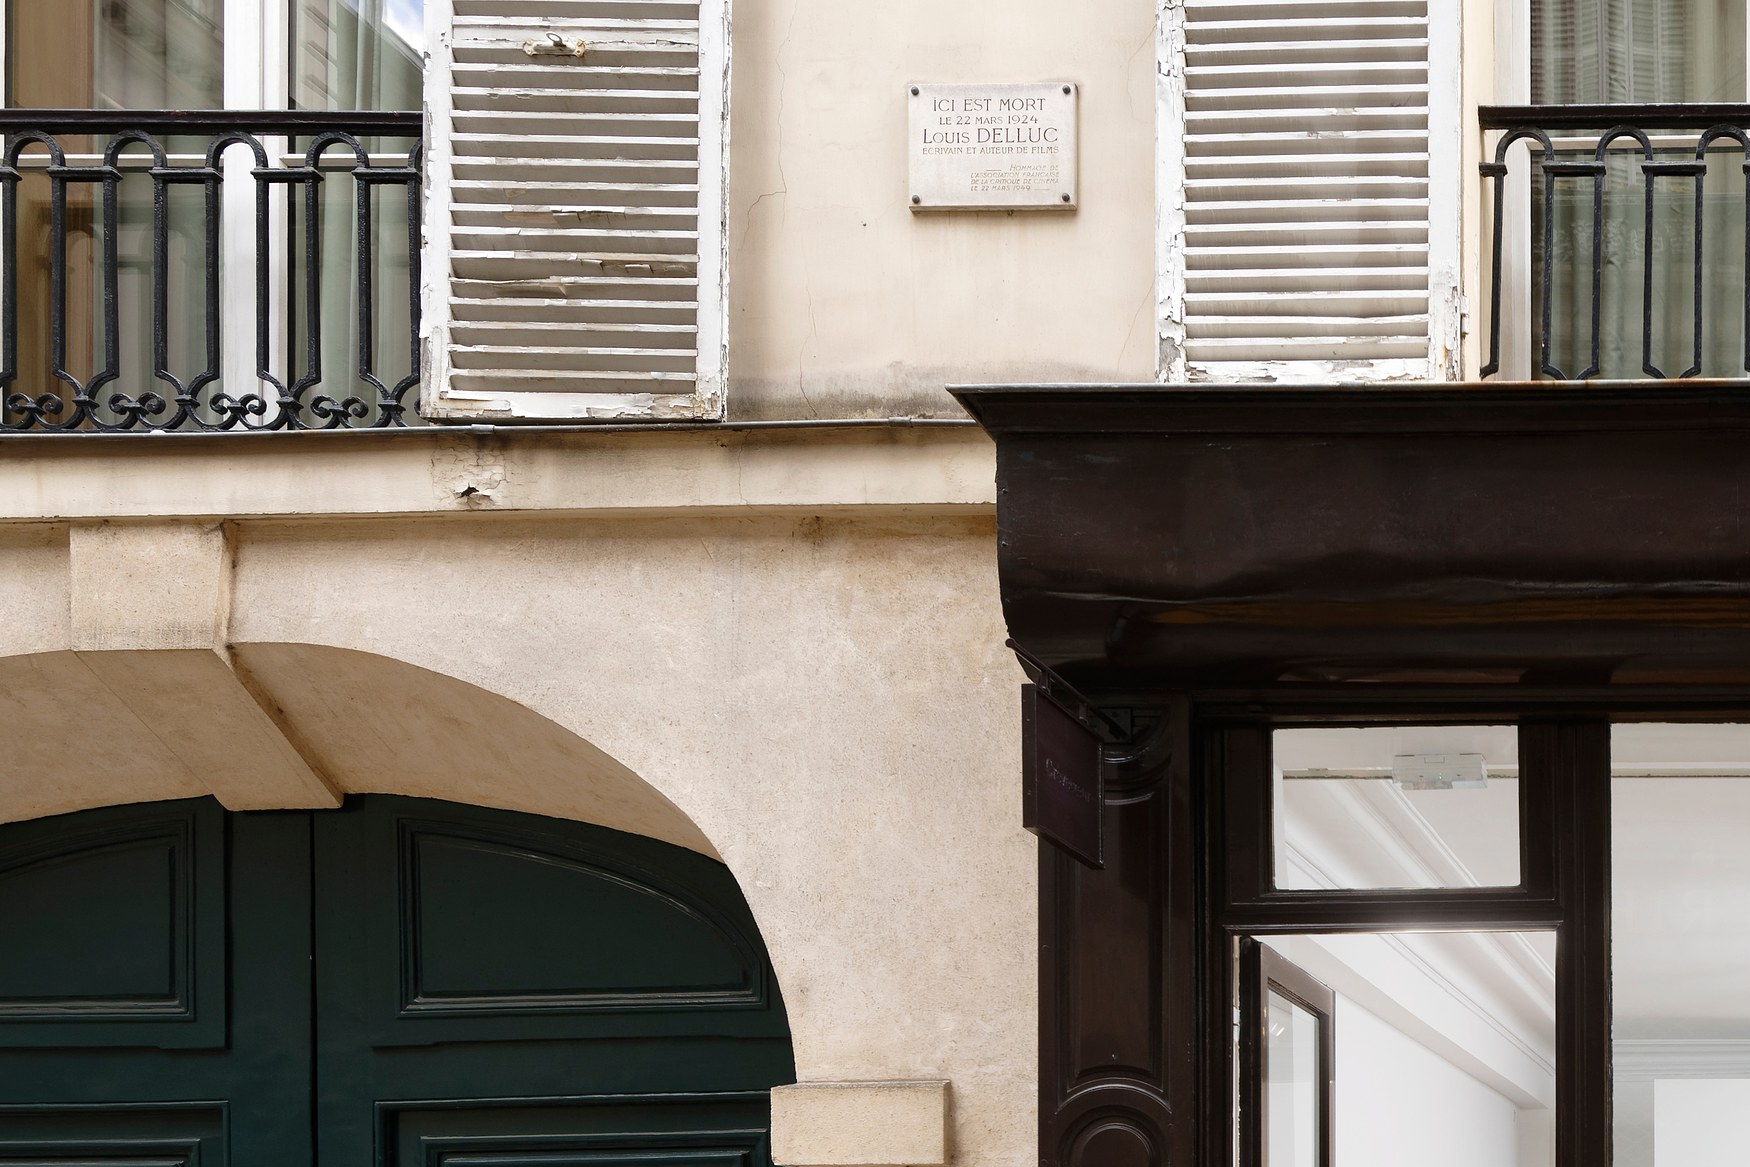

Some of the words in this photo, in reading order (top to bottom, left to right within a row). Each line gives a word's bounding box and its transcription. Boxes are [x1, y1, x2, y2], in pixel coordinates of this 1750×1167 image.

[933, 98, 955, 112] ICI
[963, 99, 992, 111] EST
[999, 98, 1046, 111] MORT
[939, 117, 952, 126] LE
[956, 116, 971, 125] 22
[975, 116, 1003, 125] MARS
[1008, 115, 1039, 125] 1924
[977, 128, 1059, 143] DELLUC
[966, 147, 977, 155] ET
[980, 147, 1014, 155] AUTEUR
[1031, 146, 1060, 154] FILMS
